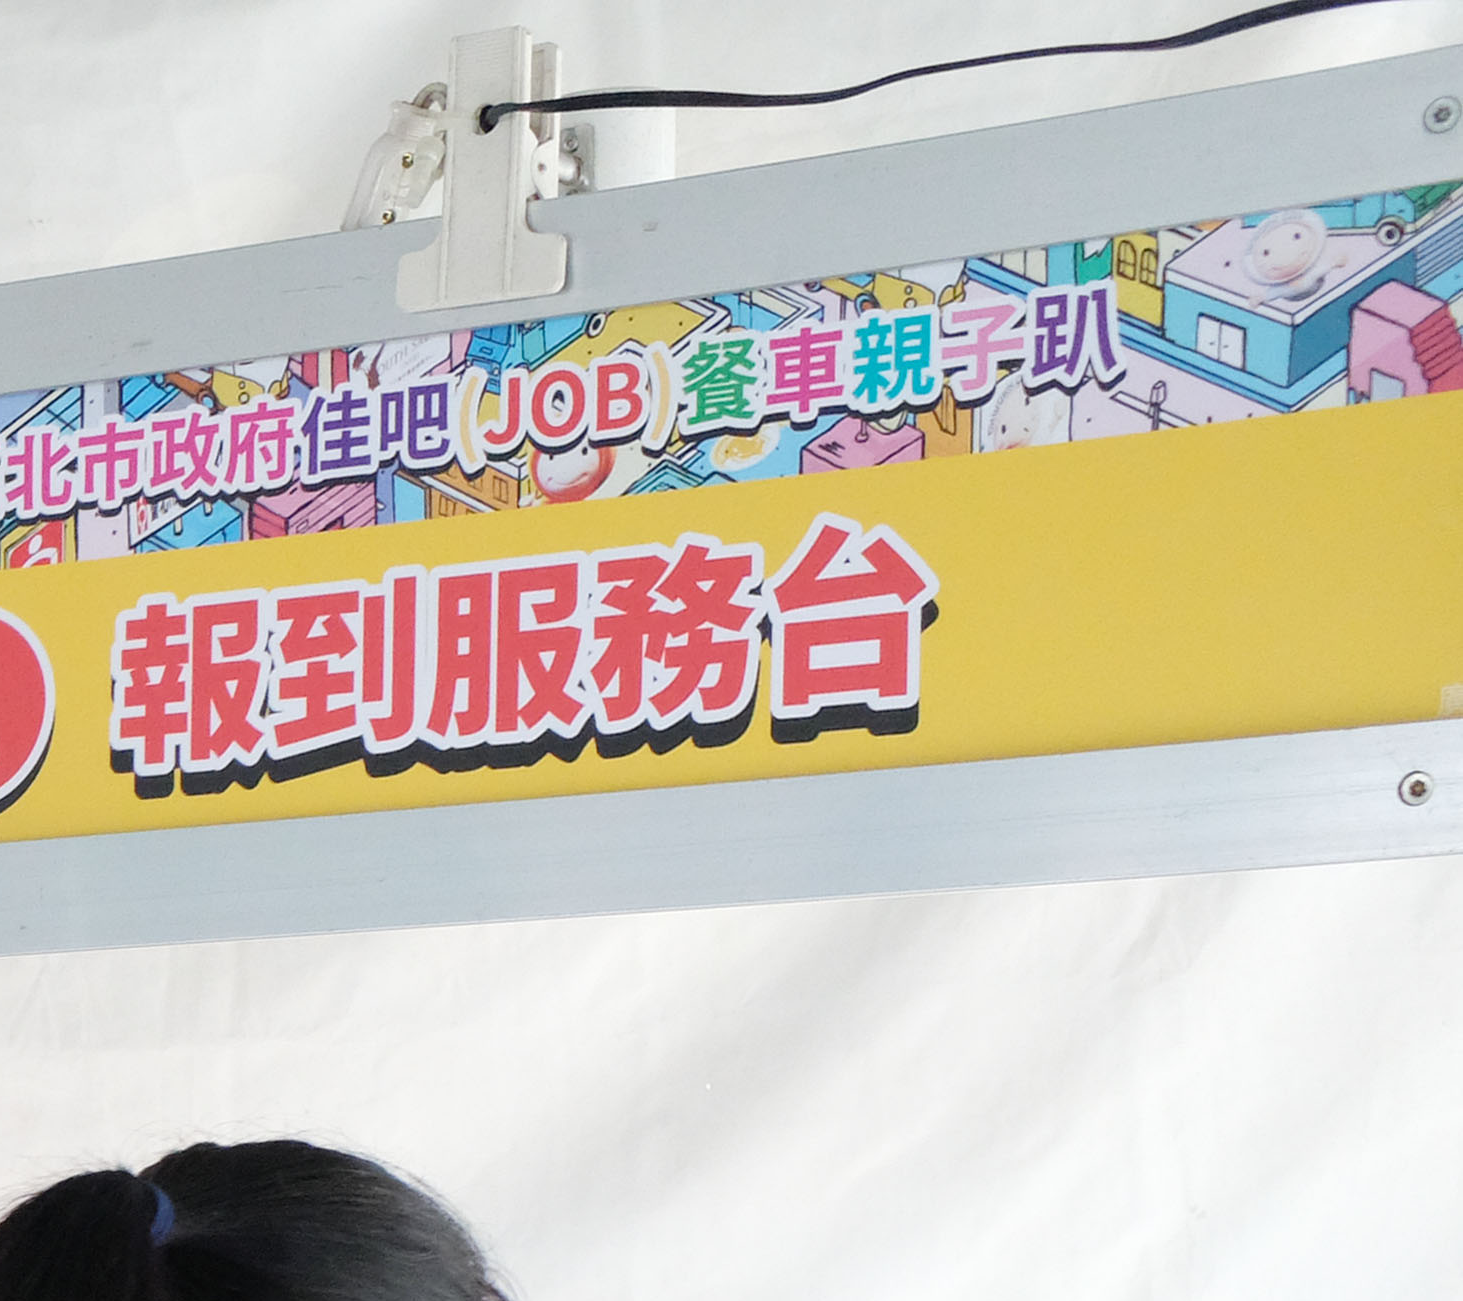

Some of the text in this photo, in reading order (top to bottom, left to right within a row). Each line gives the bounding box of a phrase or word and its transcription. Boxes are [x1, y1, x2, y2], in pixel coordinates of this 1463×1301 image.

[117, 524, 927, 767] 報到服務台
